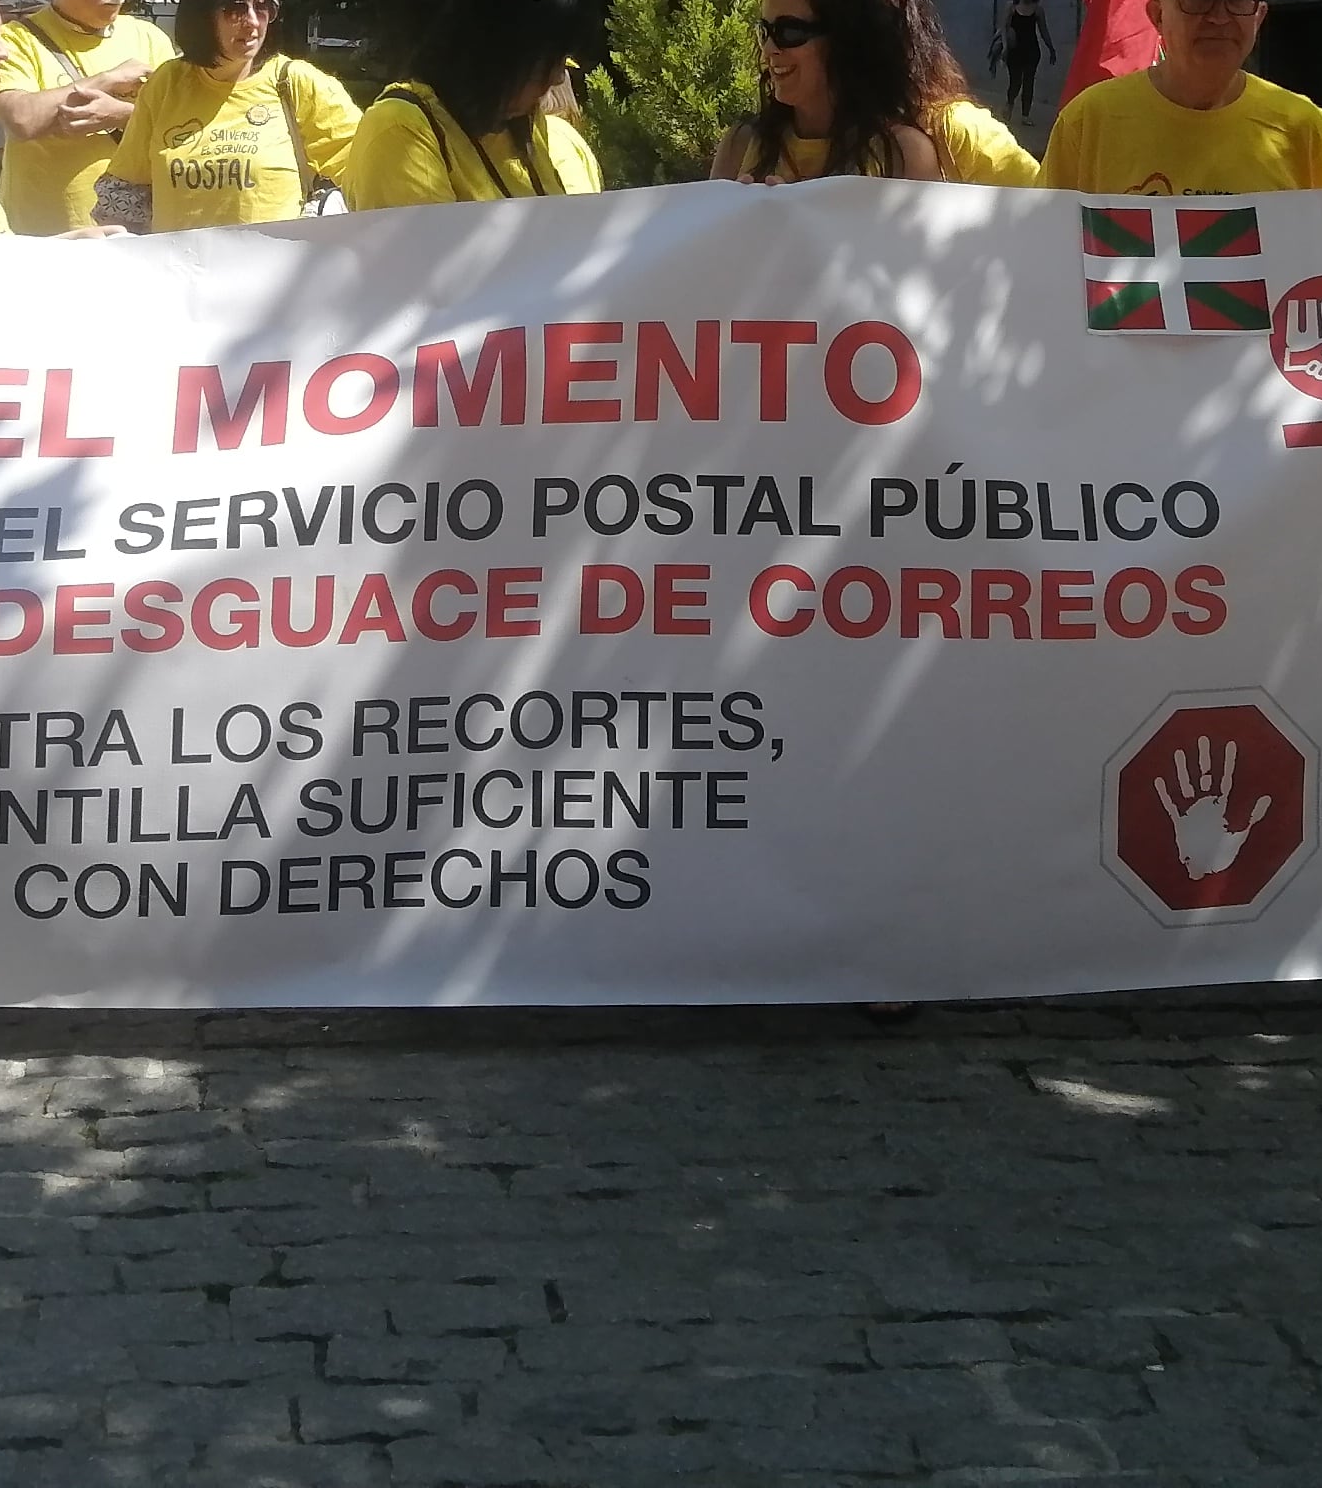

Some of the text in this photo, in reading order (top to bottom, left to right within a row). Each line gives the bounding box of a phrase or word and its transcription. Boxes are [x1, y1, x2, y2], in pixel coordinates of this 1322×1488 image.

[170, 157, 256, 191] POSTAL
[213, 144, 259, 155] SERVICIO
[172, 319, 923, 454] MOMENTO
[114, 478, 504, 555] SERVICIO
[532, 473, 841, 538] POSTAL
[869, 462, 1221, 542] PÚBLICO
[579, 563, 711, 637] DE
[748, 563, 1229, 641] CORREOS
[170, 702, 325, 764] LOS
[351, 690, 784, 763] RECORTES,
[296, 769, 749, 837] SUFICIENTE
[13, 862, 189, 920] CON
[219, 848, 652, 916] DERECHOS
